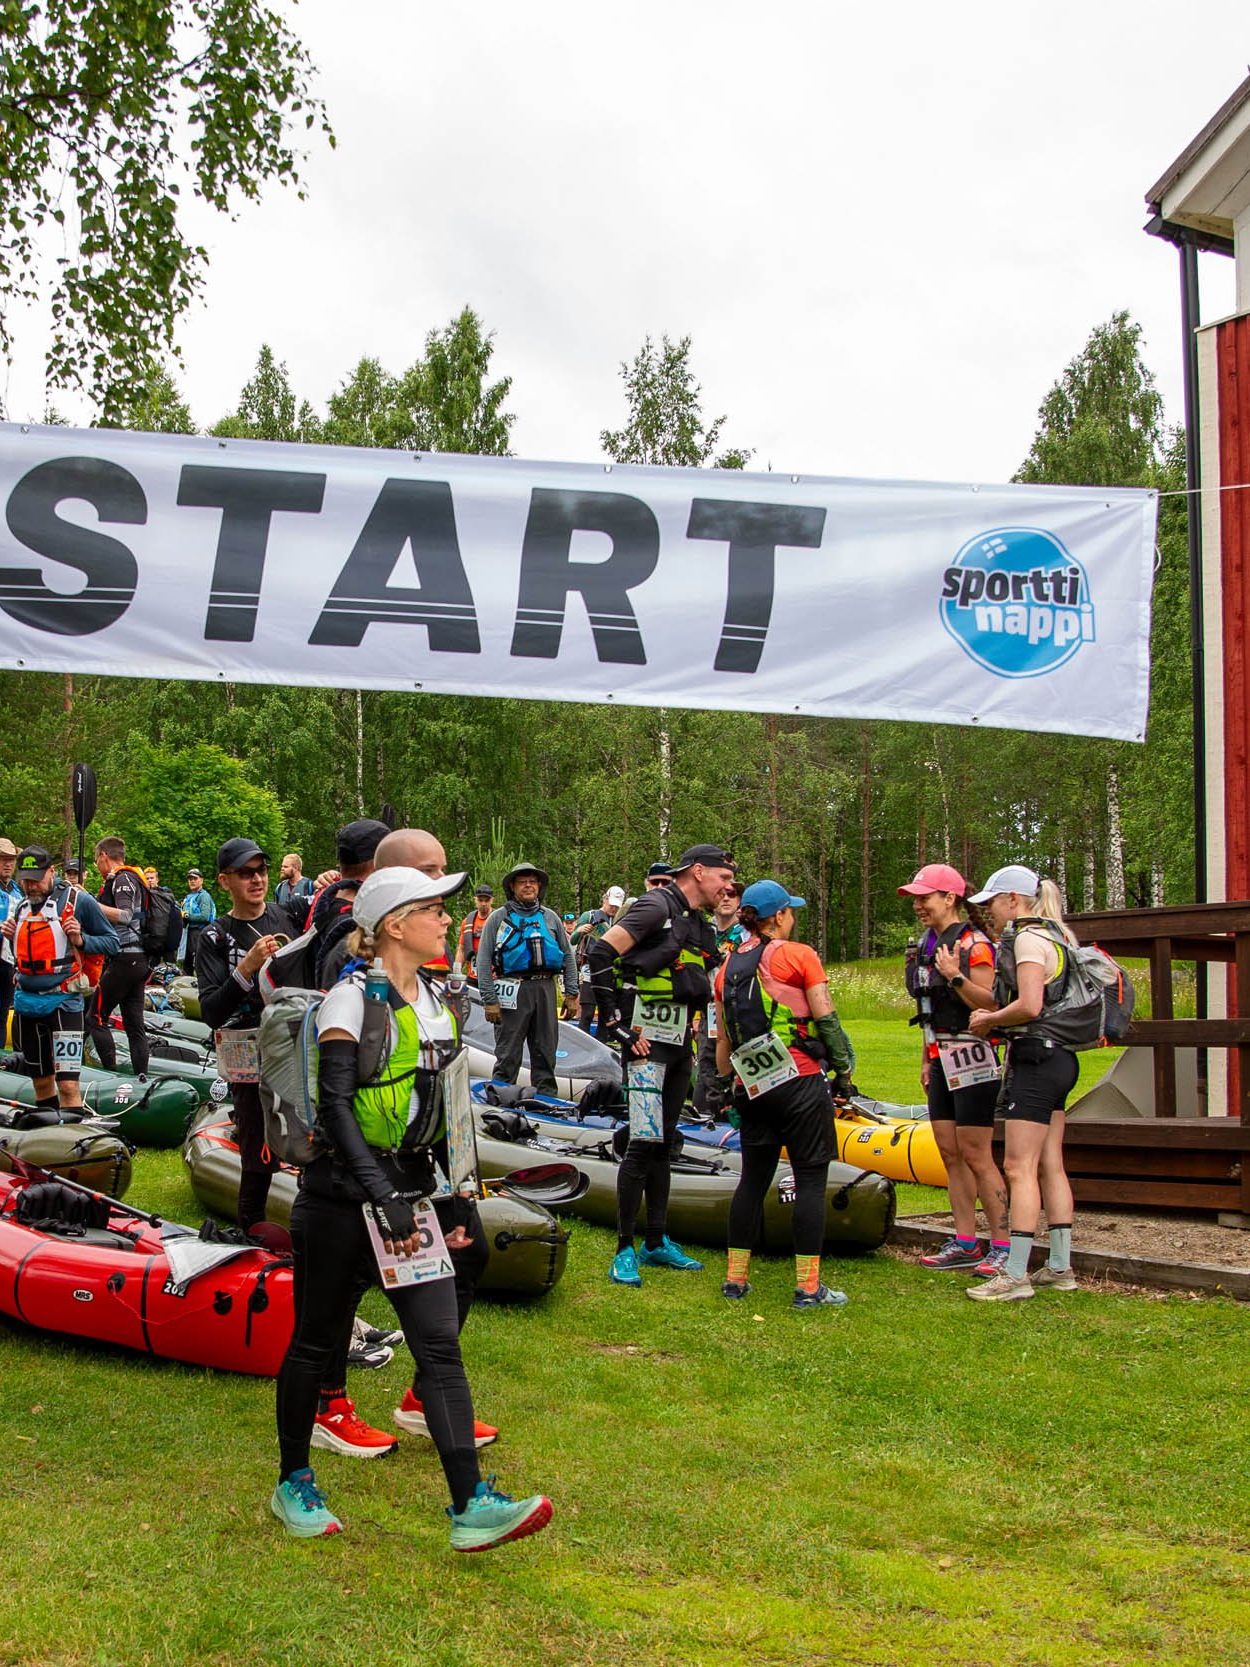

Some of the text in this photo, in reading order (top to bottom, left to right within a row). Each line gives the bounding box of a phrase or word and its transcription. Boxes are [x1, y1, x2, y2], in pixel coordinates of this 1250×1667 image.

[941, 566, 1080, 607] sportti
[974, 602, 1095, 646] nappi
[640, 1002, 681, 1025] 301
[741, 1044, 784, 1077] 301
[949, 1043, 986, 1069] 110
[163, 1282, 186, 1297] 202
